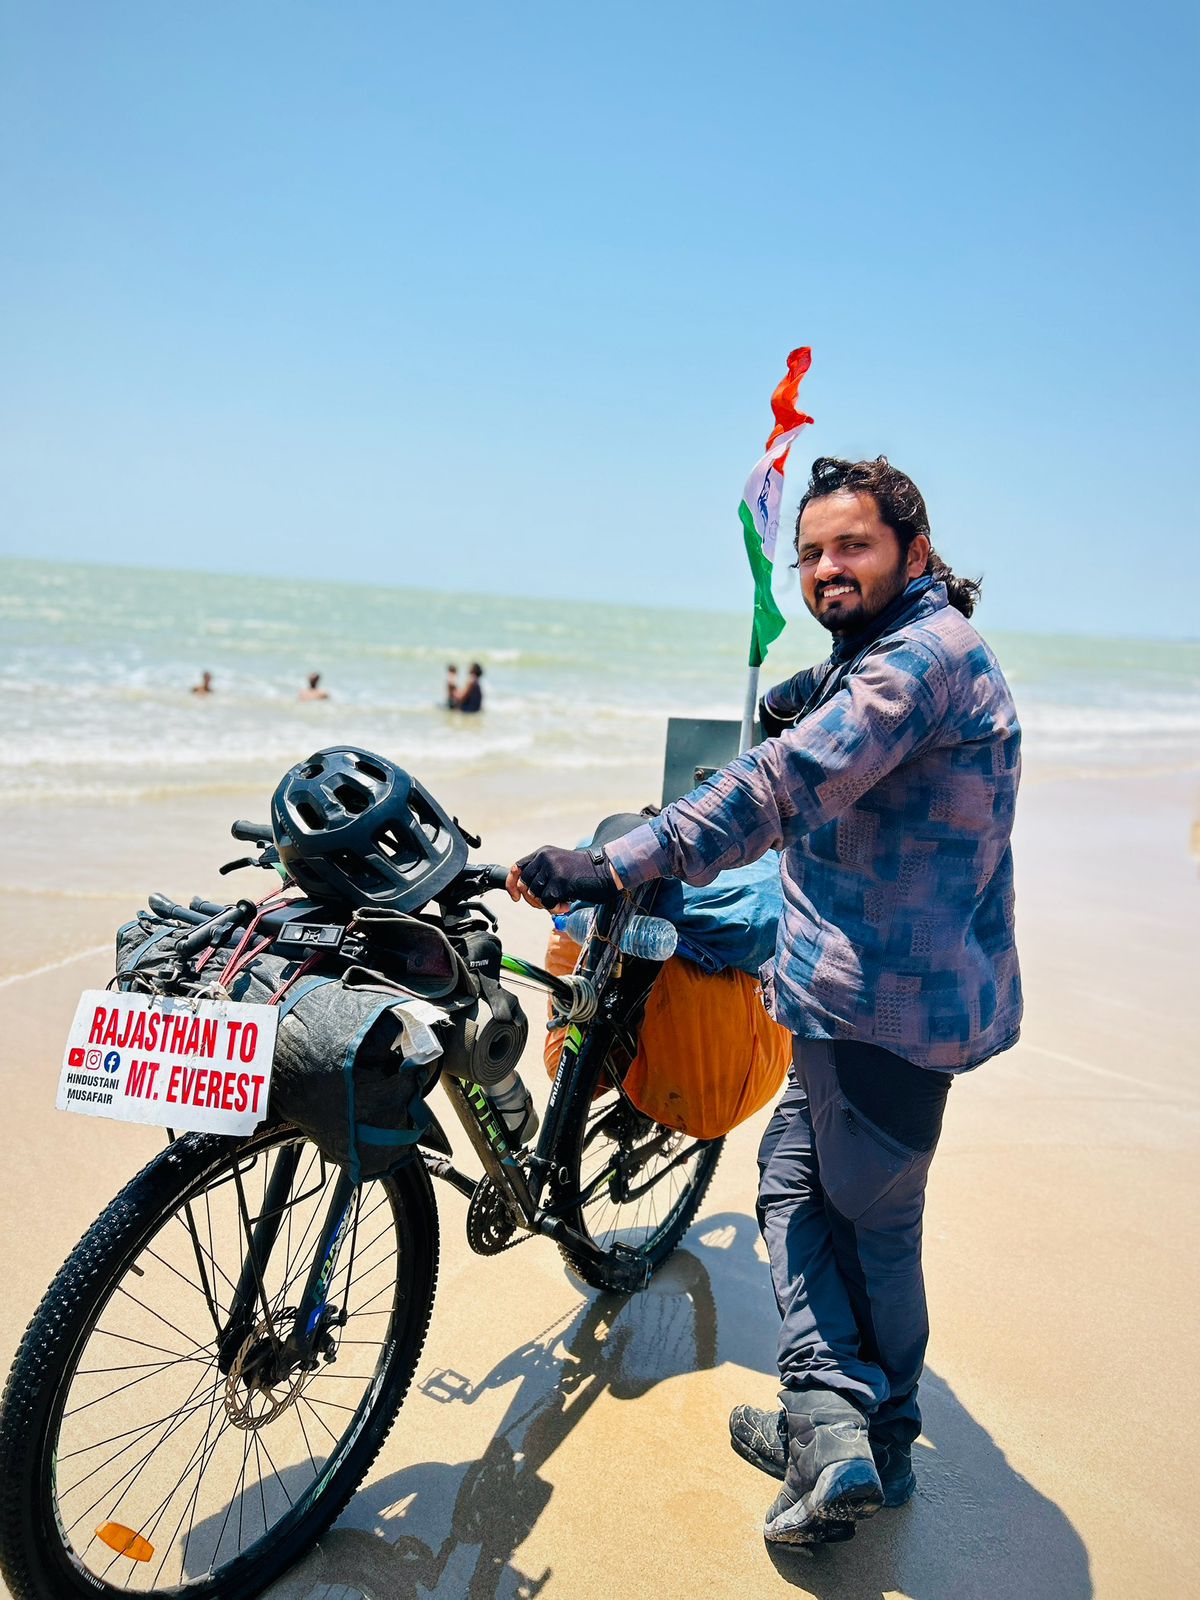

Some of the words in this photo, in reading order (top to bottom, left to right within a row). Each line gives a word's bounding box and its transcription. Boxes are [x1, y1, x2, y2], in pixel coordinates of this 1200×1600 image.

[88, 1007, 218, 1058] RAJASTHAN
[226, 1020, 259, 1063] TO
[66, 1072, 120, 1090] HINDUSTANI
[66, 1088, 113, 1105] MUSAFAIR
[124, 1059, 160, 1101] MT.
[165, 1065, 265, 1113] EVEREST
